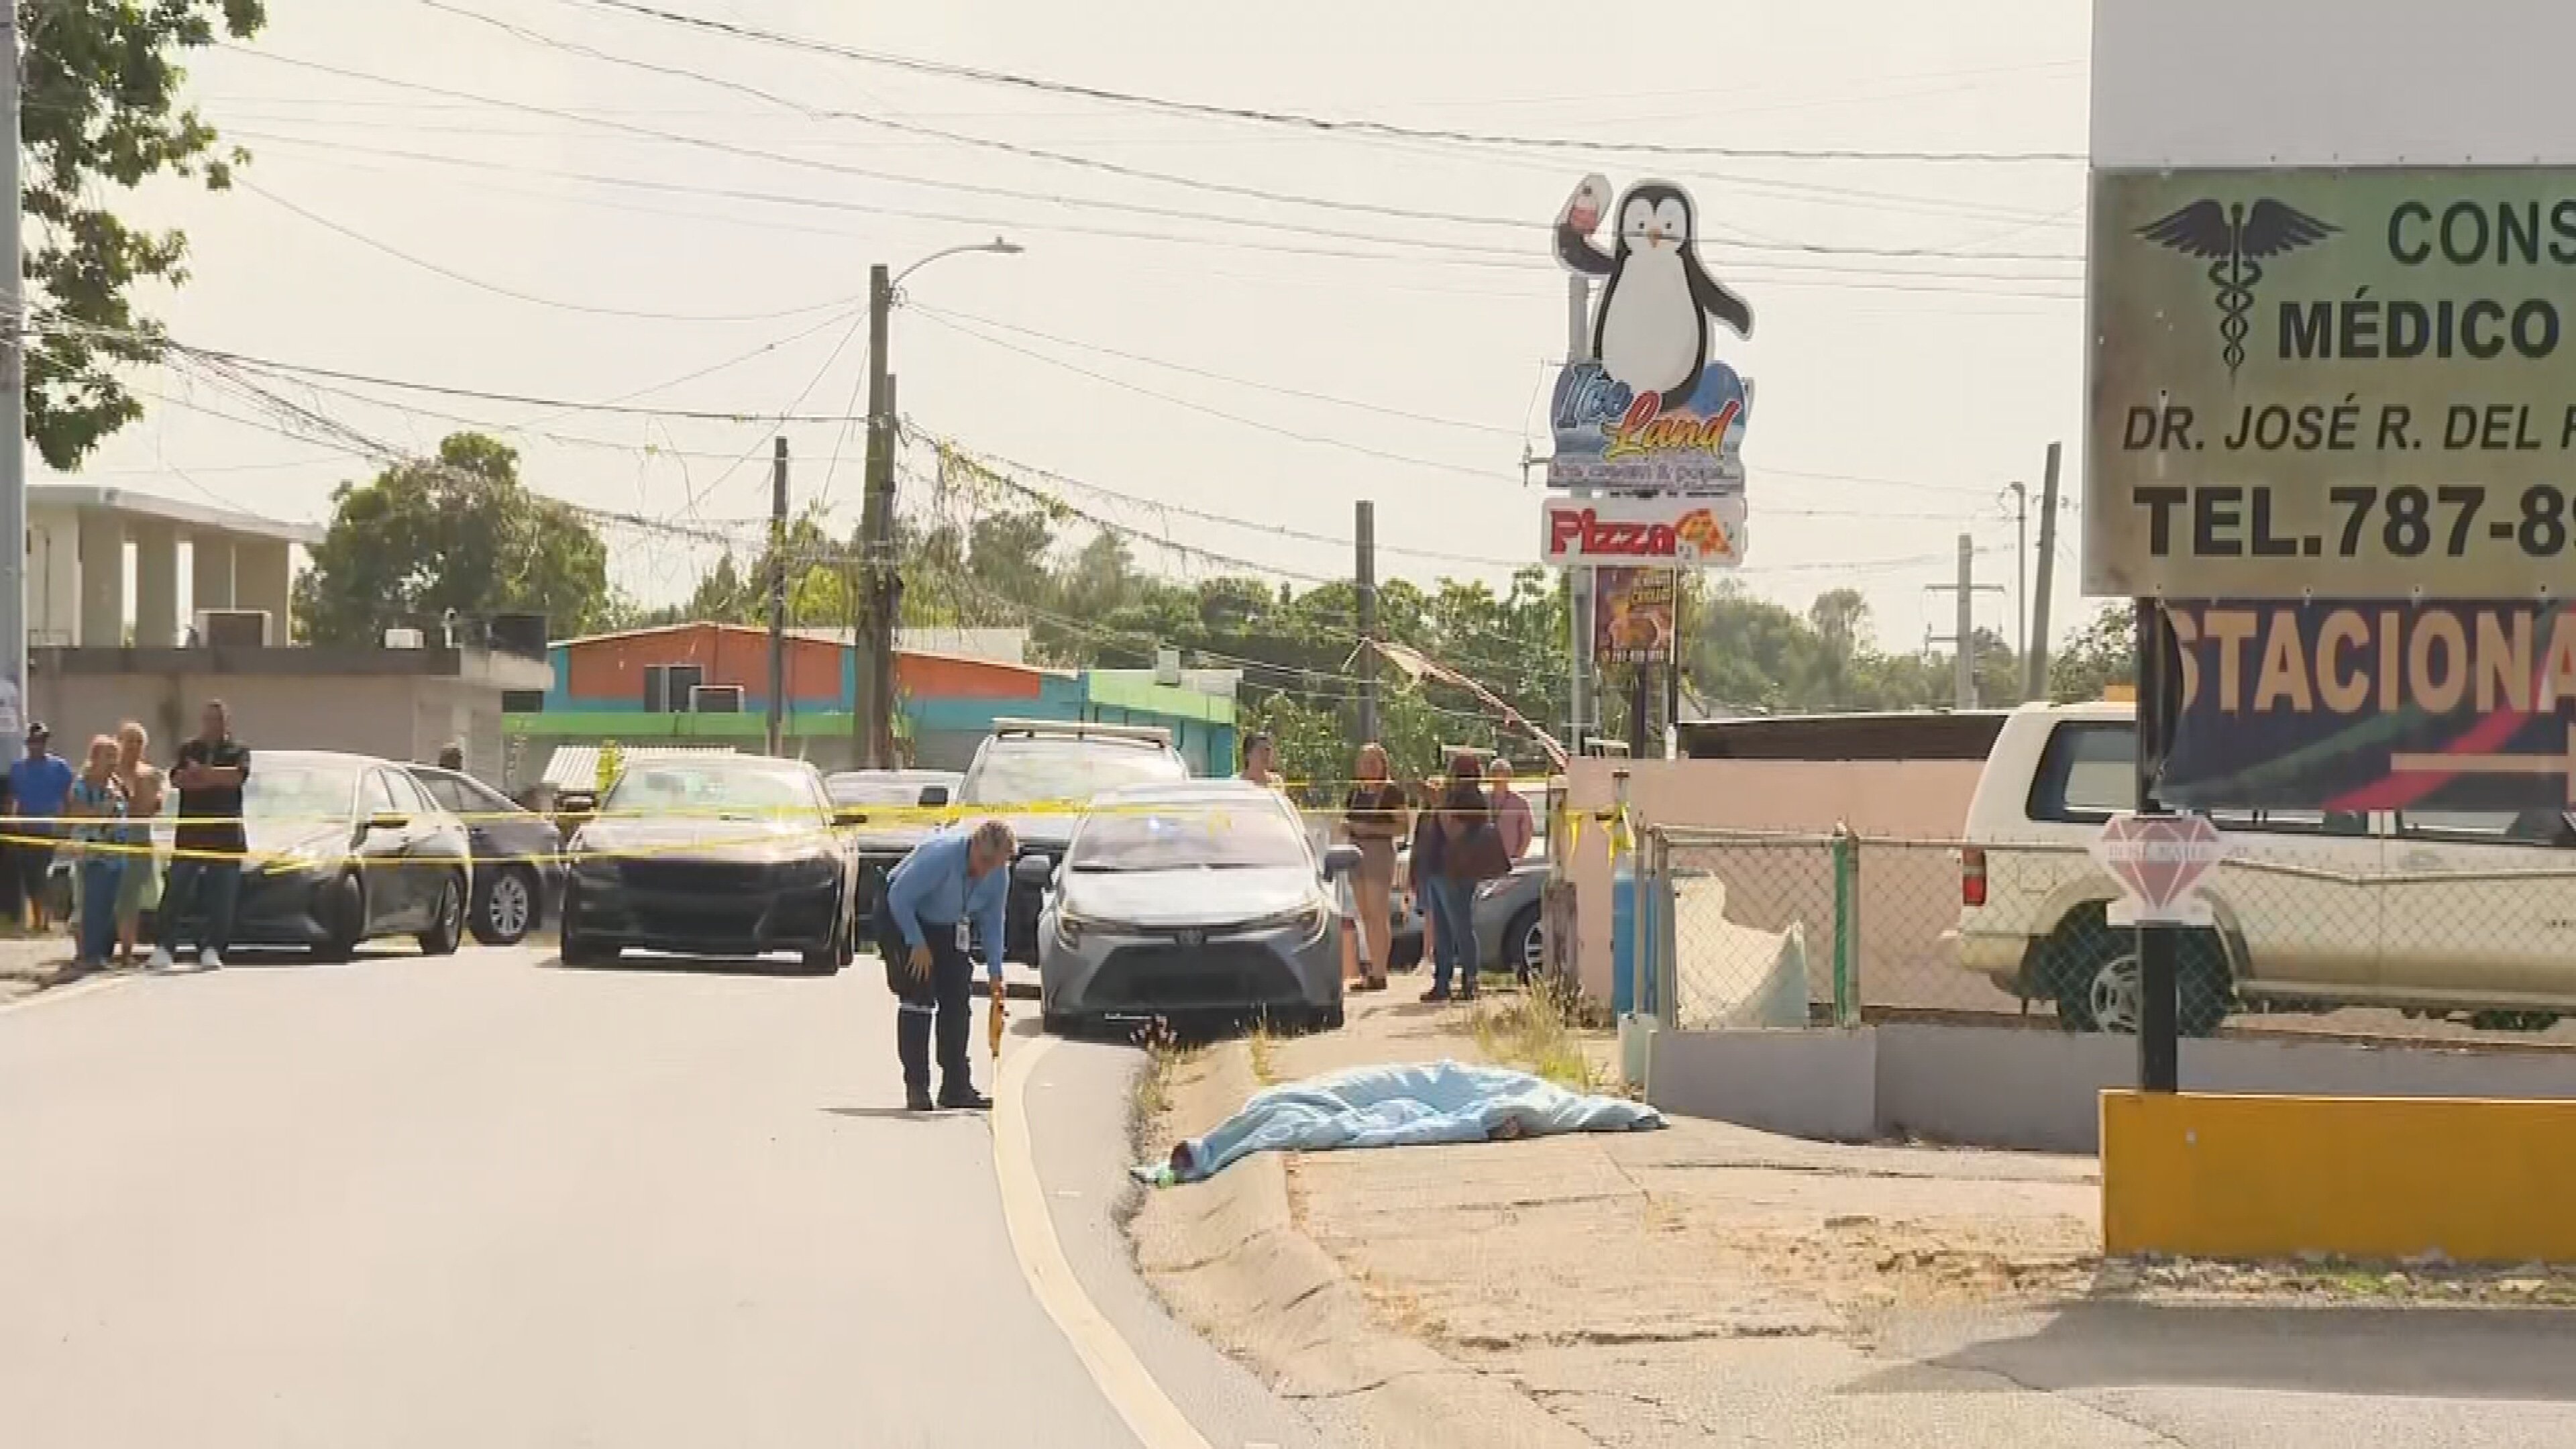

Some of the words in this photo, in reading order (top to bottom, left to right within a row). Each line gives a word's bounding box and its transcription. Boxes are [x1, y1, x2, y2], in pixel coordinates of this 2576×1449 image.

[2388, 201, 2576, 266] CONS
[2279, 285, 2560, 359] MÉDICO
[1601, 390, 1740, 461] Land
[2123, 406, 2206, 450] DR.
[2224, 392, 2361, 450] JOSÉ
[2376, 406, 2422, 450] R.
[2443, 406, 2543, 450] DEL
[1550, 508, 1676, 556] Pizza
[2133, 484, 2576, 557] TEL.787-8
